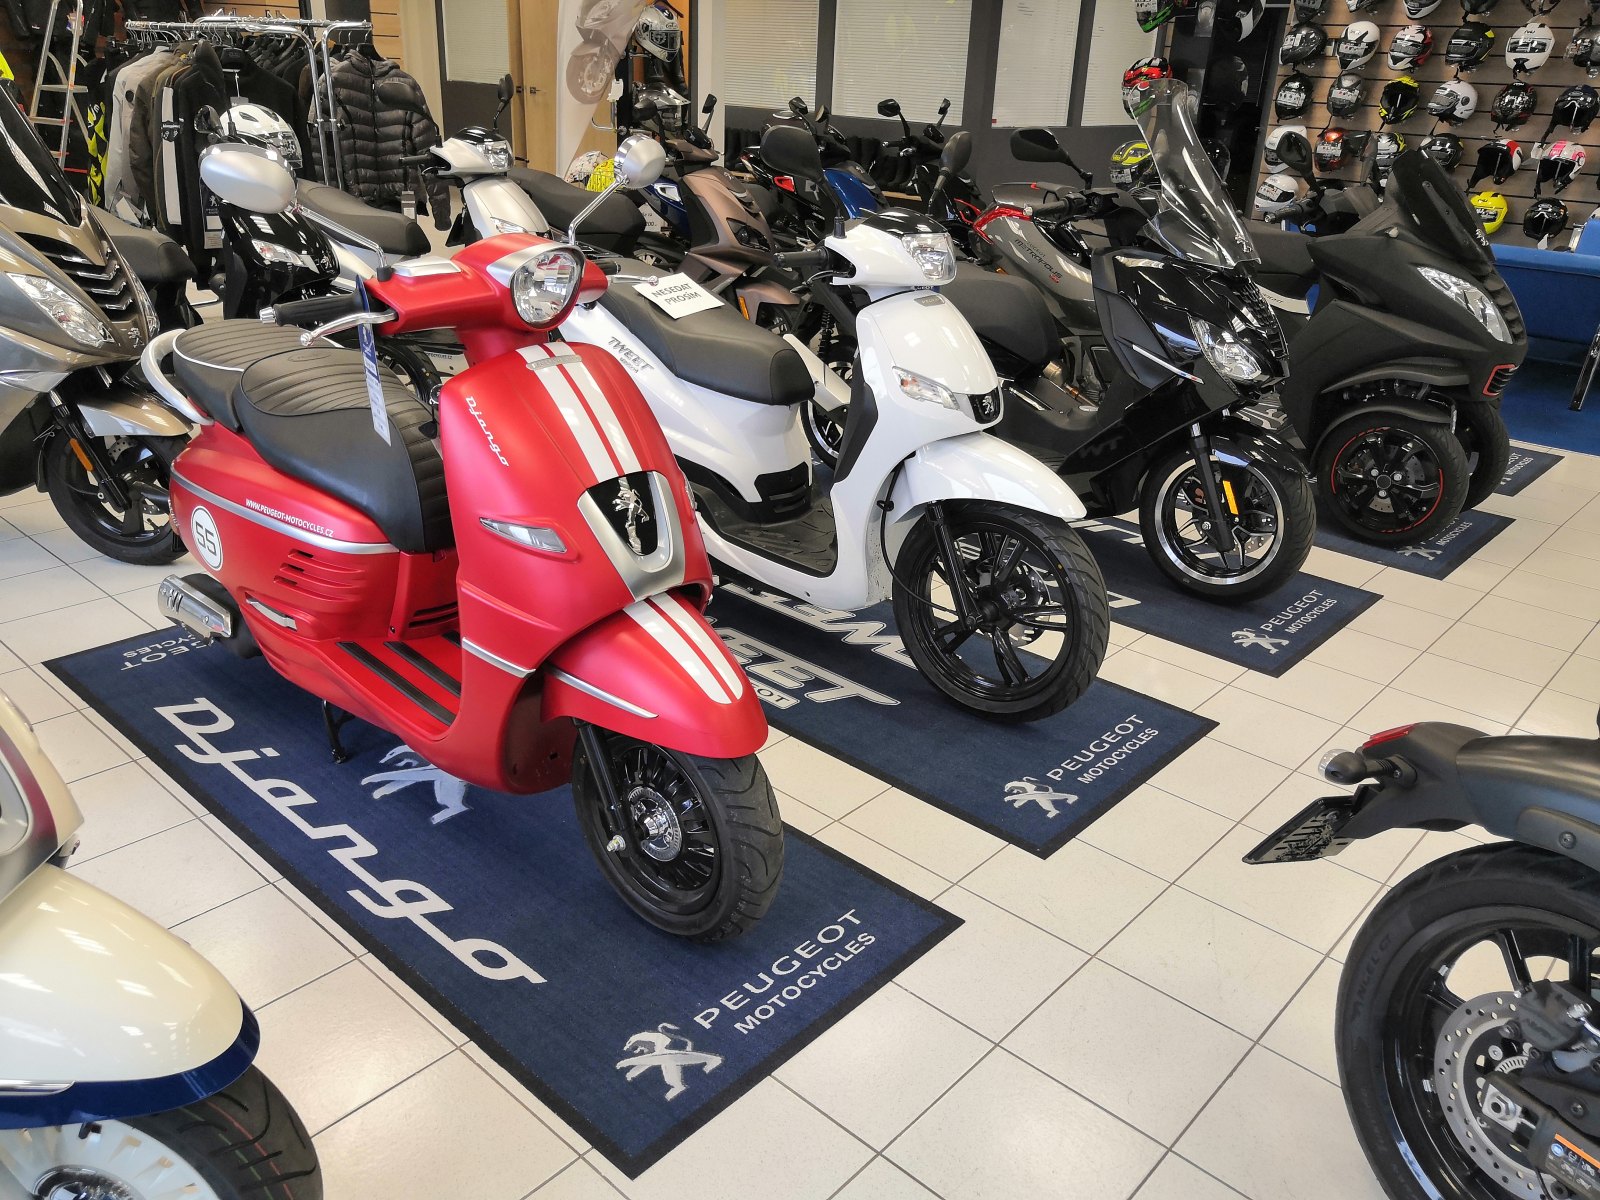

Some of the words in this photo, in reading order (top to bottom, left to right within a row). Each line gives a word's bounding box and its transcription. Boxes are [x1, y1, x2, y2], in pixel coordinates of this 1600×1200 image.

[651, 283, 693, 298] NESEDAT
[608, 336, 655, 371] TWEET
[465, 395, 510, 467] Django
[245, 498, 334, 538] WWW.PEUGEOT-MOTOCYCLES.CZ
[1260, 589, 1324, 632] PEUGEOT
[1284, 598, 1338, 634] MOTOCYCLES
[1045, 714, 1144, 781] PEUGEOT
[1076, 727, 1159, 784] MOTOCYCLES
[152, 696, 548, 984] Django
[693, 908, 861, 1030] PEUGEOT
[733, 932, 876, 1035] MOTOCYCLES
